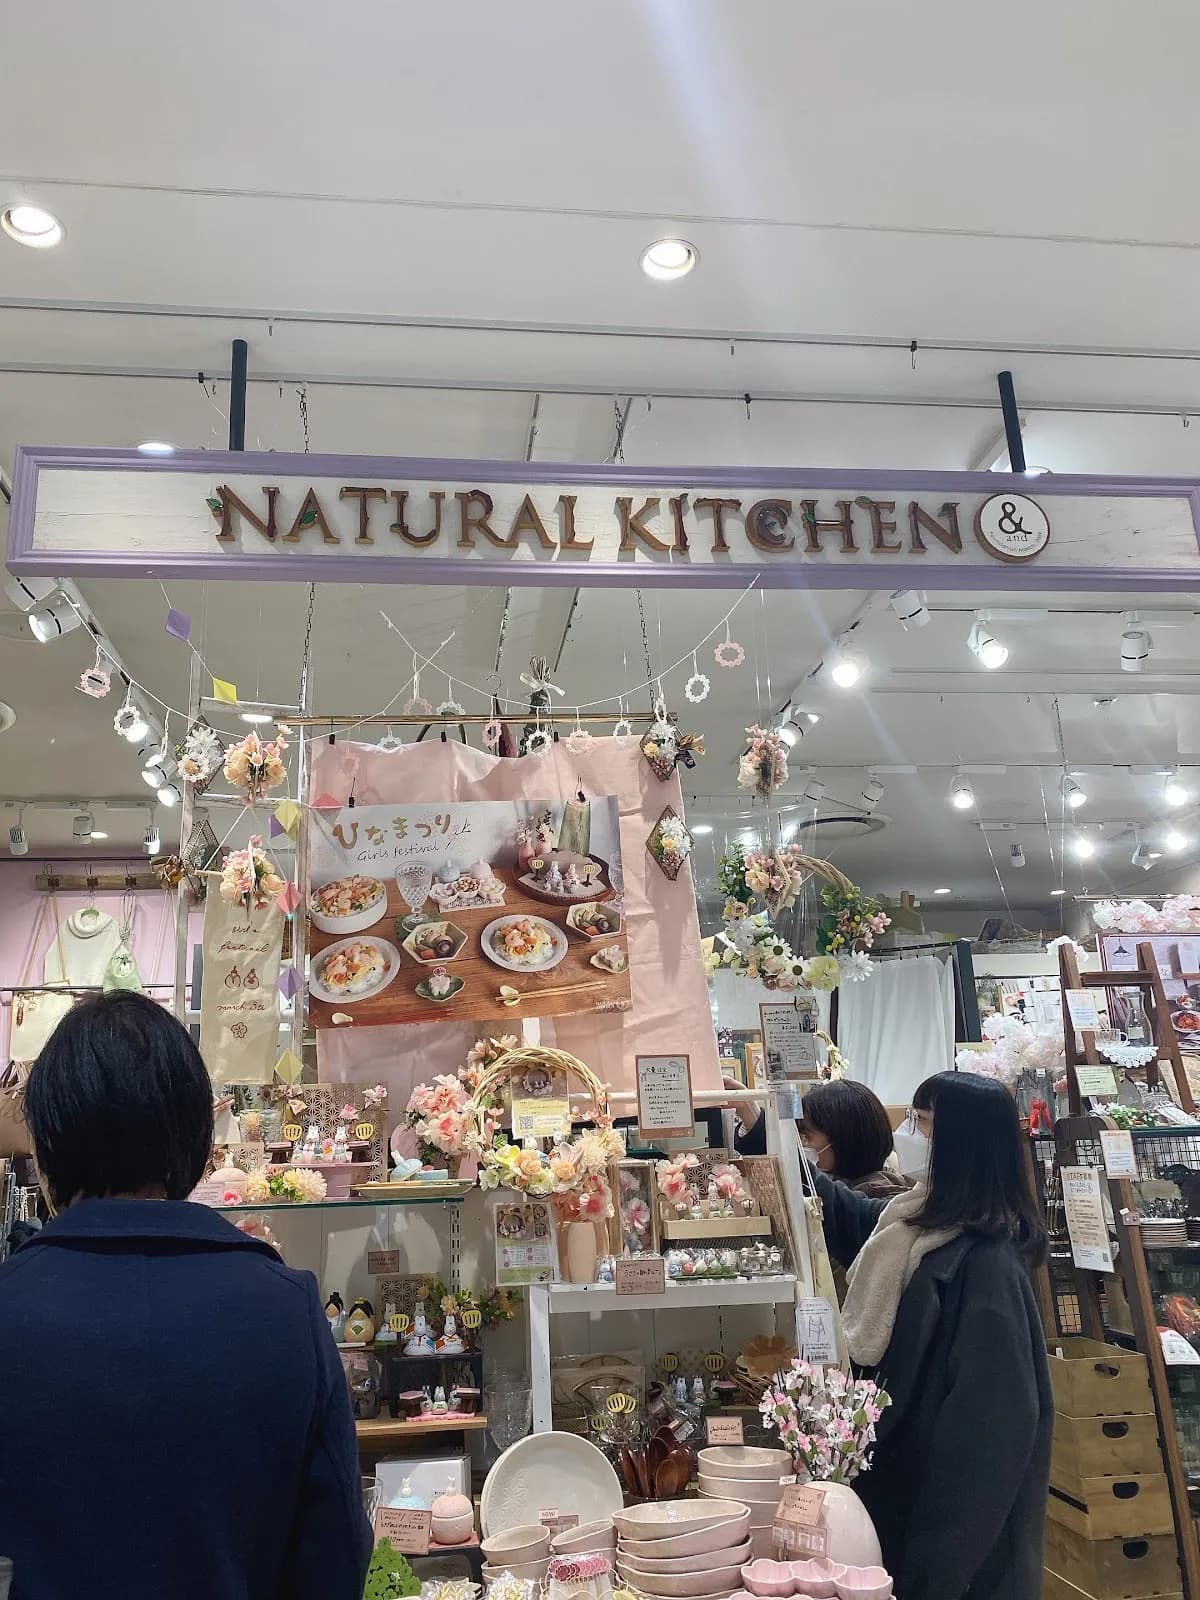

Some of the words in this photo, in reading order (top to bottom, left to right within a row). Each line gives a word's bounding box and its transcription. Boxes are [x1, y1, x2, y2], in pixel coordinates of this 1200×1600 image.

[213, 484, 595, 551] NATURAL
[614, 492, 964, 555] KITCHEN
[332, 813, 452, 850] ひなまつり
